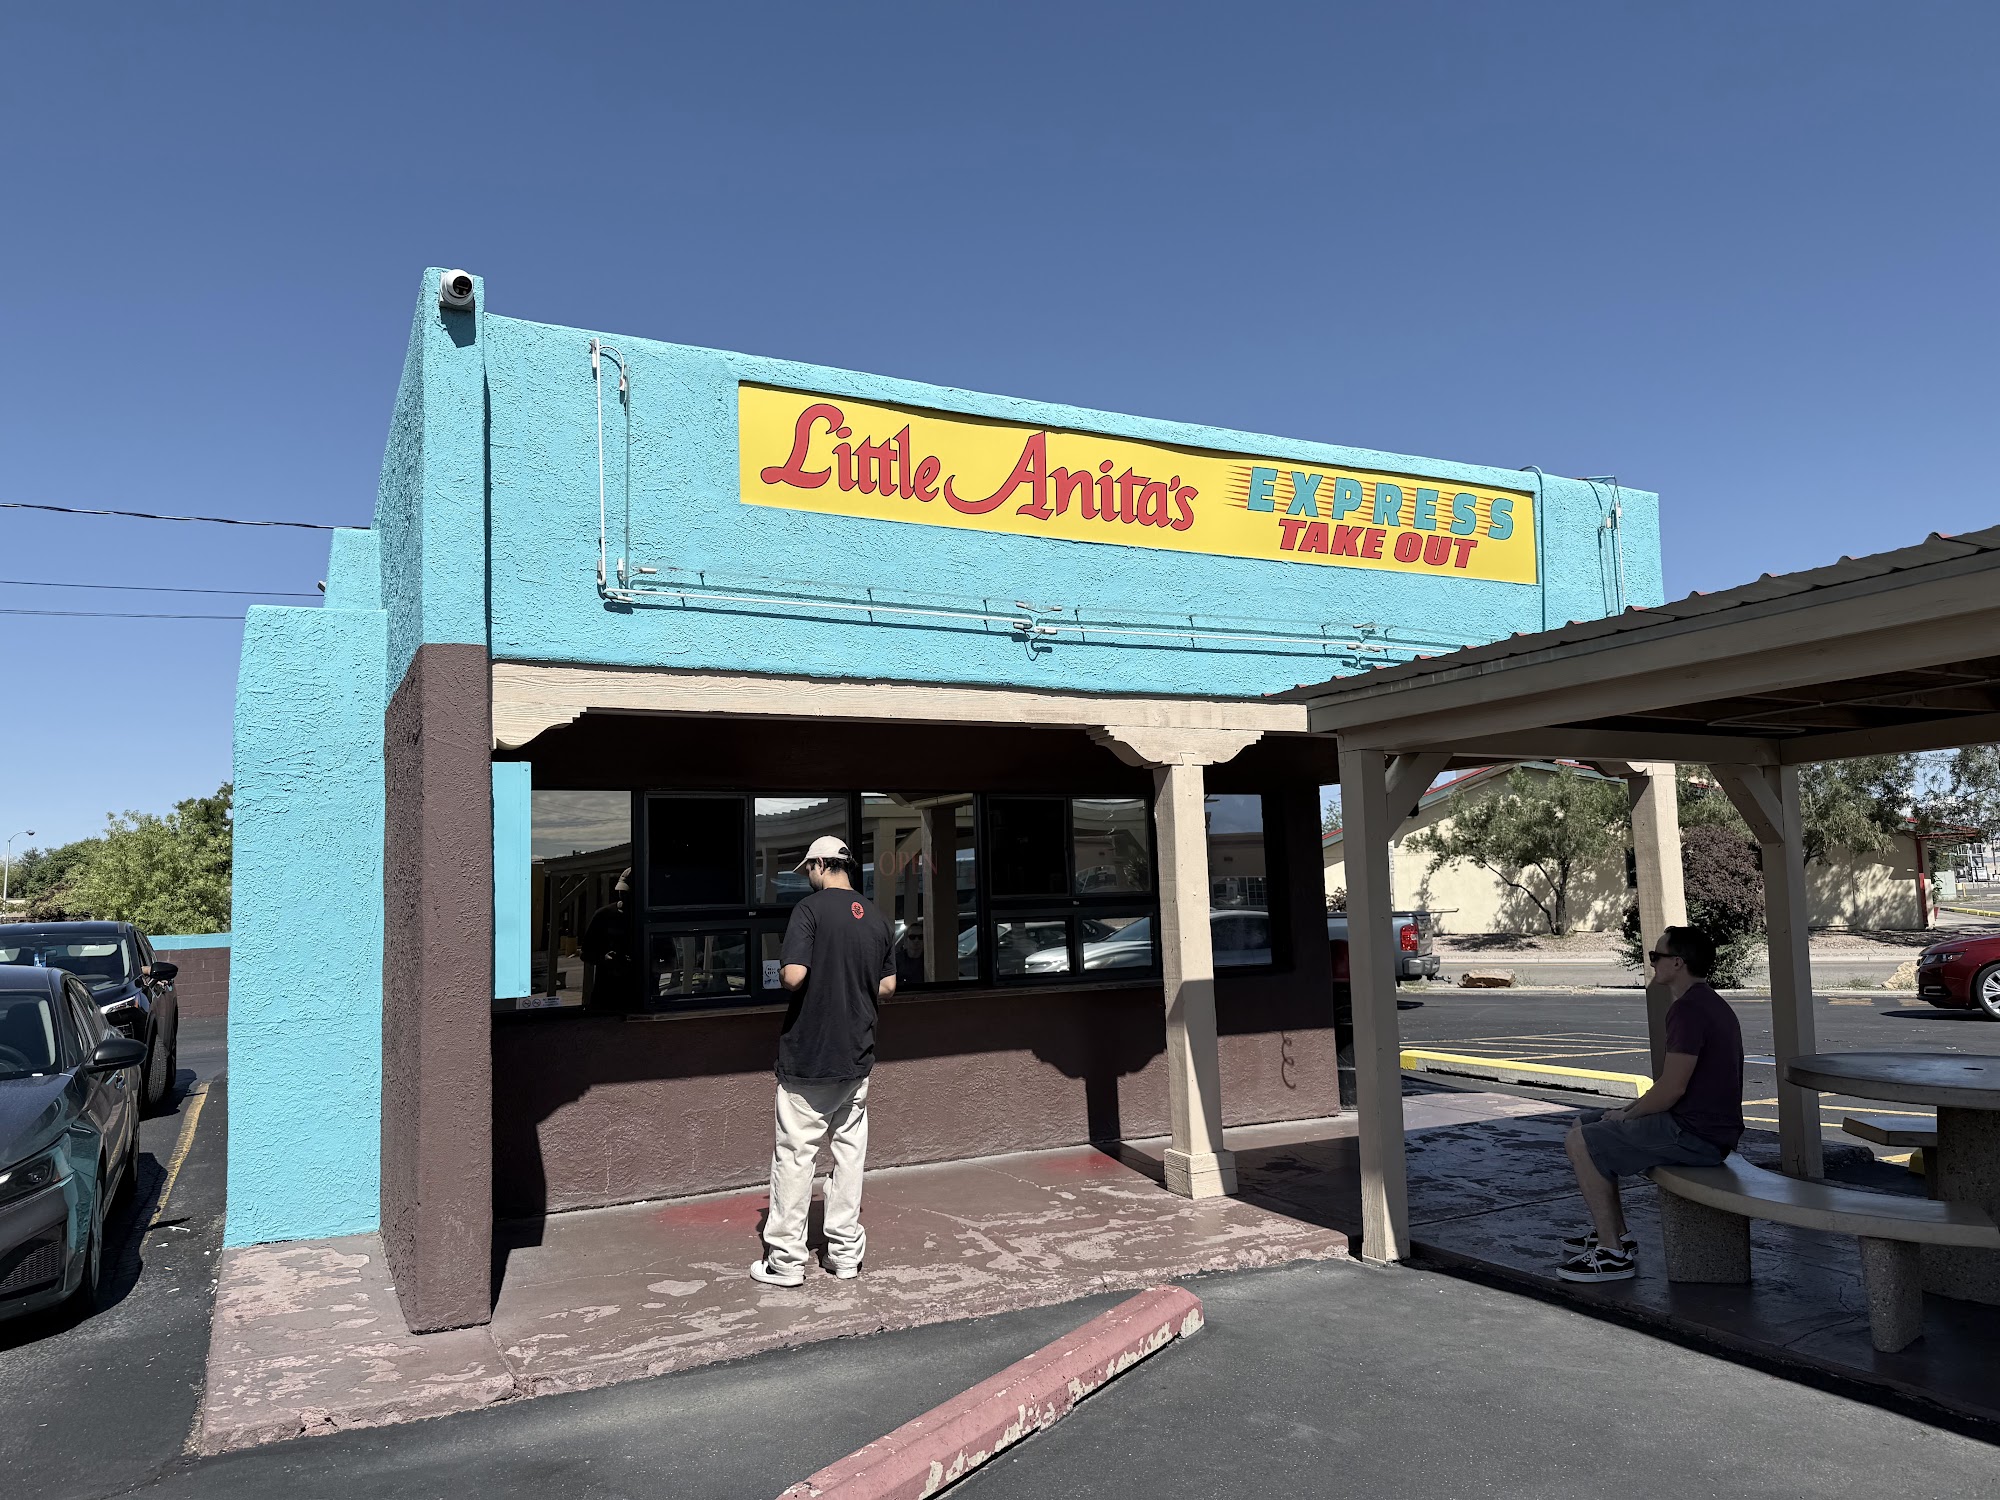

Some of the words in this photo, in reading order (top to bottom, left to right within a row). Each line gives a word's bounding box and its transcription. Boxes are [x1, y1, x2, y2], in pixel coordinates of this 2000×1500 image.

[760, 403, 941, 502] Little
[943, 430, 1199, 531] Anita's
[1247, 466, 1514, 540] EXPRESS
[1278, 518, 1387, 559] TAKE
[1393, 531, 1478, 568] OUT
[879, 851, 938, 876] OPEN
